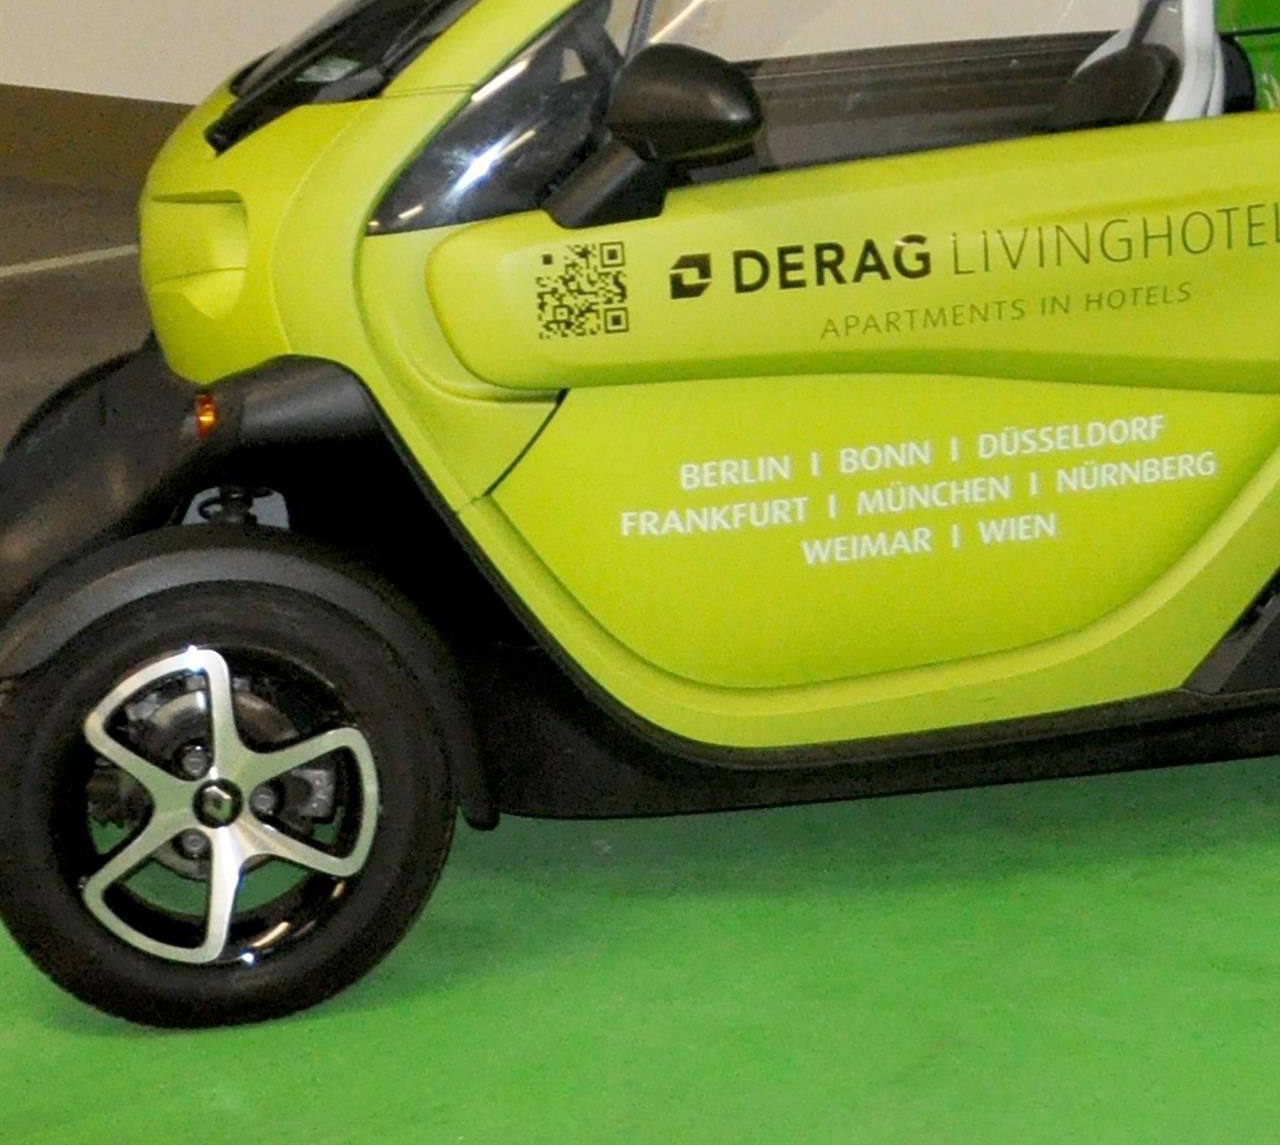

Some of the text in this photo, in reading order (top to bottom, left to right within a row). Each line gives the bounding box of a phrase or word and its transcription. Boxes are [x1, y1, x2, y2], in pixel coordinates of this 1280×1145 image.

[732, 234, 931, 294] DERAG
[820, 281, 1192, 340] APARTMENTS IN HOTELS
[679, 455, 792, 491] BERLIN
[839, 440, 932, 474] BONN
[977, 414, 1164, 460] DÜSSELDORF
[620, 496, 809, 536] FRANKFURT
[856, 475, 1012, 515] MÜNCHEN
[1056, 451, 1217, 493] NÜRNBERG
[801, 526, 933, 565] WEIMAR
[978, 513, 1057, 545] WIEN
